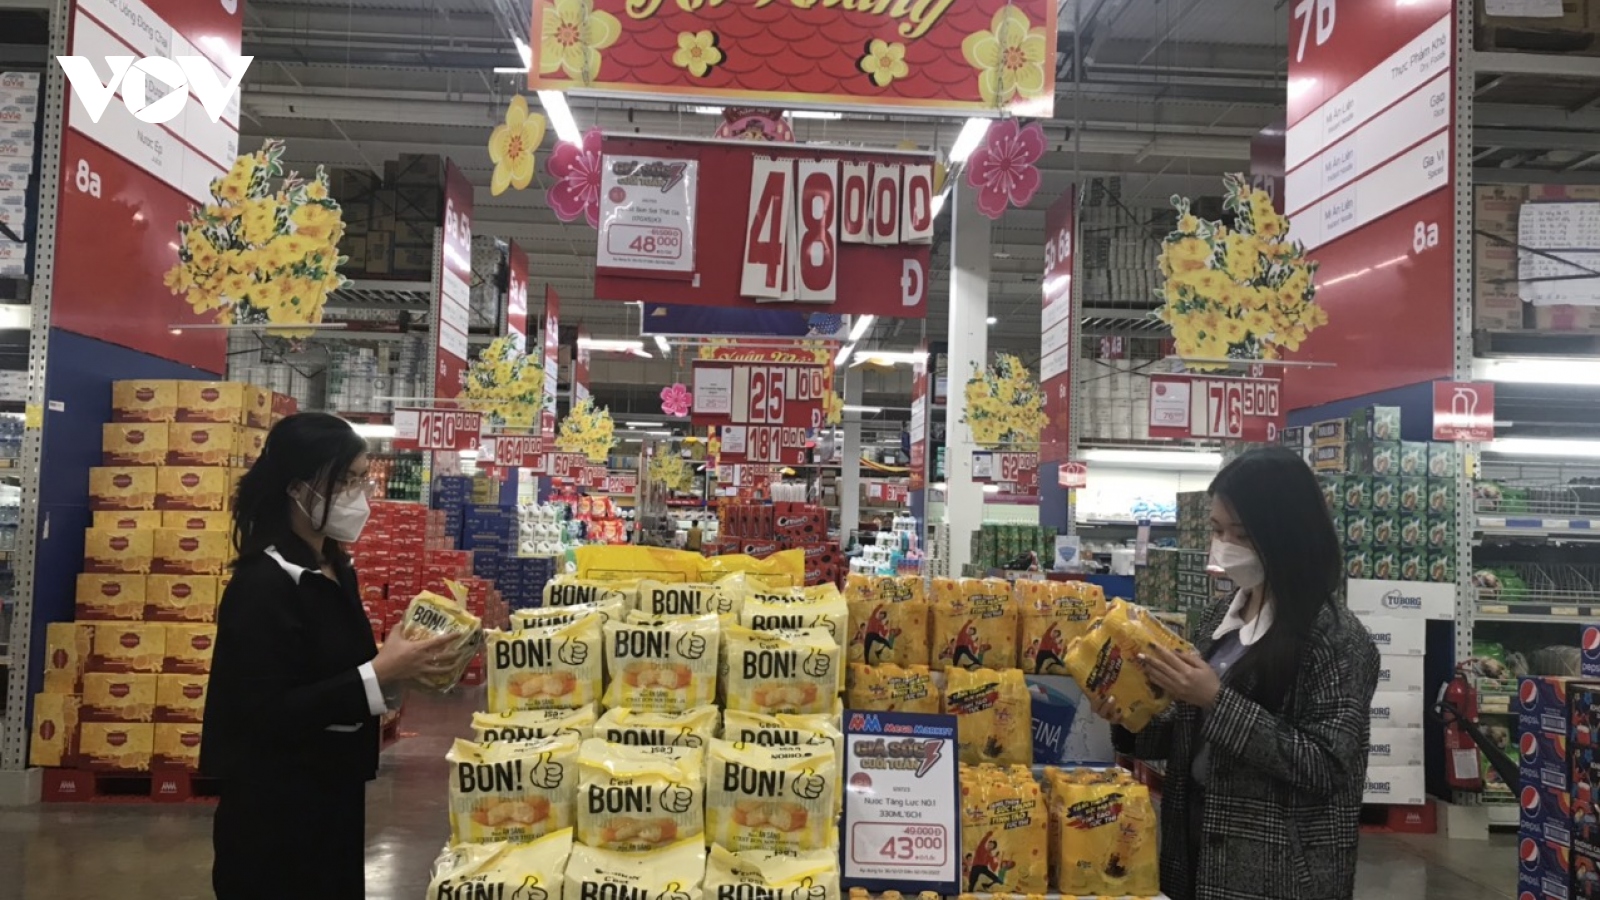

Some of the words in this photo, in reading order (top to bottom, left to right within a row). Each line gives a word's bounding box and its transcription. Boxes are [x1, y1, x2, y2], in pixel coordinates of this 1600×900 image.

[75, 158, 101, 199] 8a
[1413, 220, 1439, 254] 8a
[751, 372, 784, 420] 25
[652, 589, 701, 615] BON!
[1387, 595, 1422, 606] TUBORG
[495, 638, 553, 670] BON!
[615, 630, 670, 658] BON!
[743, 650, 797, 680] BON!
[1582, 663, 1600, 674] peps
[854, 738, 887, 758] GIÁ
[888, 738, 925, 759] SỐC
[459, 761, 523, 793] BON!
[723, 761, 786, 797] BON!
[588, 783, 652, 814] BON!
